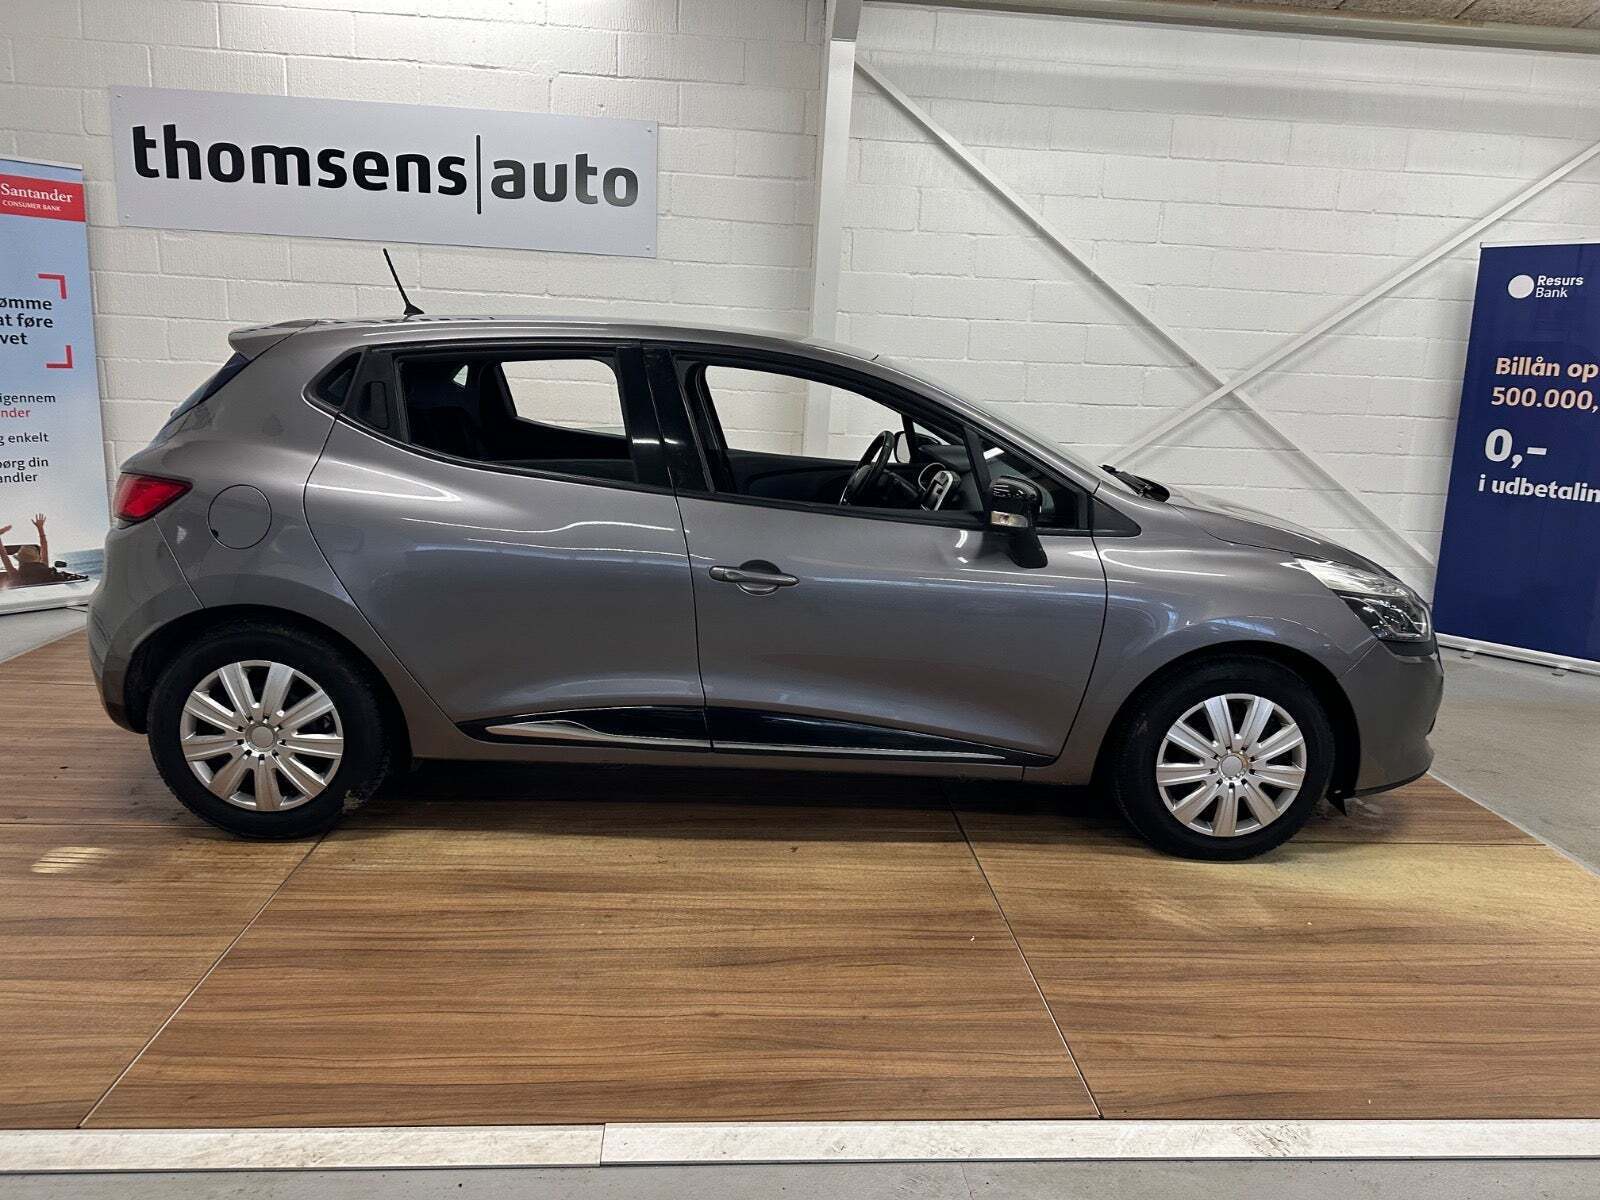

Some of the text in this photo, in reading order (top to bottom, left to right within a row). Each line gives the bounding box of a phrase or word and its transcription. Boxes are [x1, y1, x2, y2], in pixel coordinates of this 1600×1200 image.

[0, 183, 73, 203] Santander
[2, 200, 61, 212] CONSUMER BANK
[1537, 275, 1584, 287] Resurs
[1535, 287, 1568, 299] Bank
[16, 313, 53, 329] føre
[0, 332, 28, 345] vet
[1495, 356, 1599, 383] Billån op
[1491, 387, 1600, 413] 500.000,
[1, 408, 31, 418] nder
[8, 432, 49, 443] enkelt
[28, 457, 49, 468] din
[1478, 474, 1600, 503] i udbetalin
